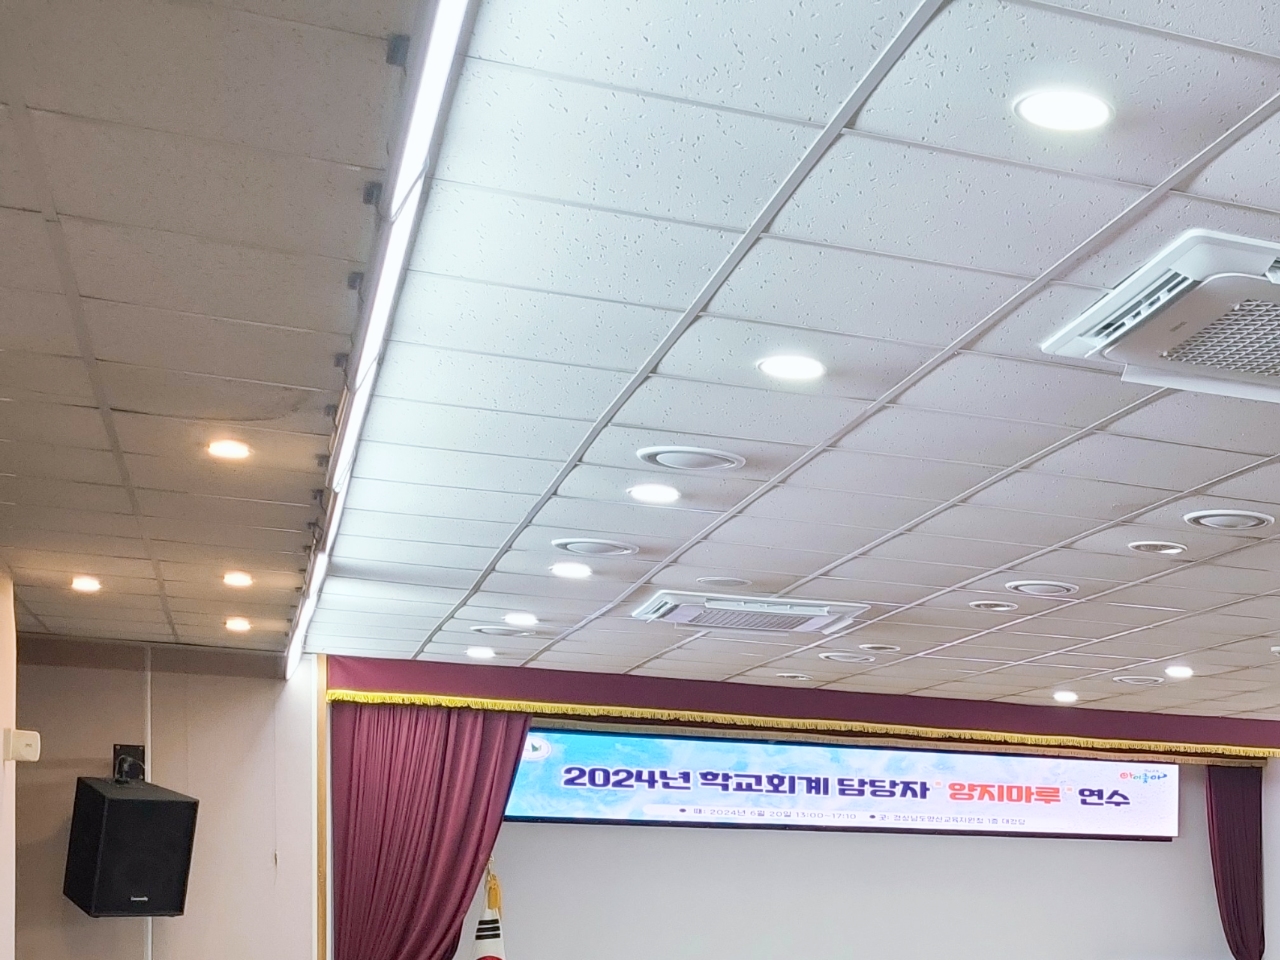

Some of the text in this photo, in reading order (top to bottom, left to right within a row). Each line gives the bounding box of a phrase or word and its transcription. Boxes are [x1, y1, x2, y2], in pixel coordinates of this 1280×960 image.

[563, 766, 1131, 807] 2024년 학교회계 담당자 양지마루 연수
[710, 808, 746, 817] 2024년
